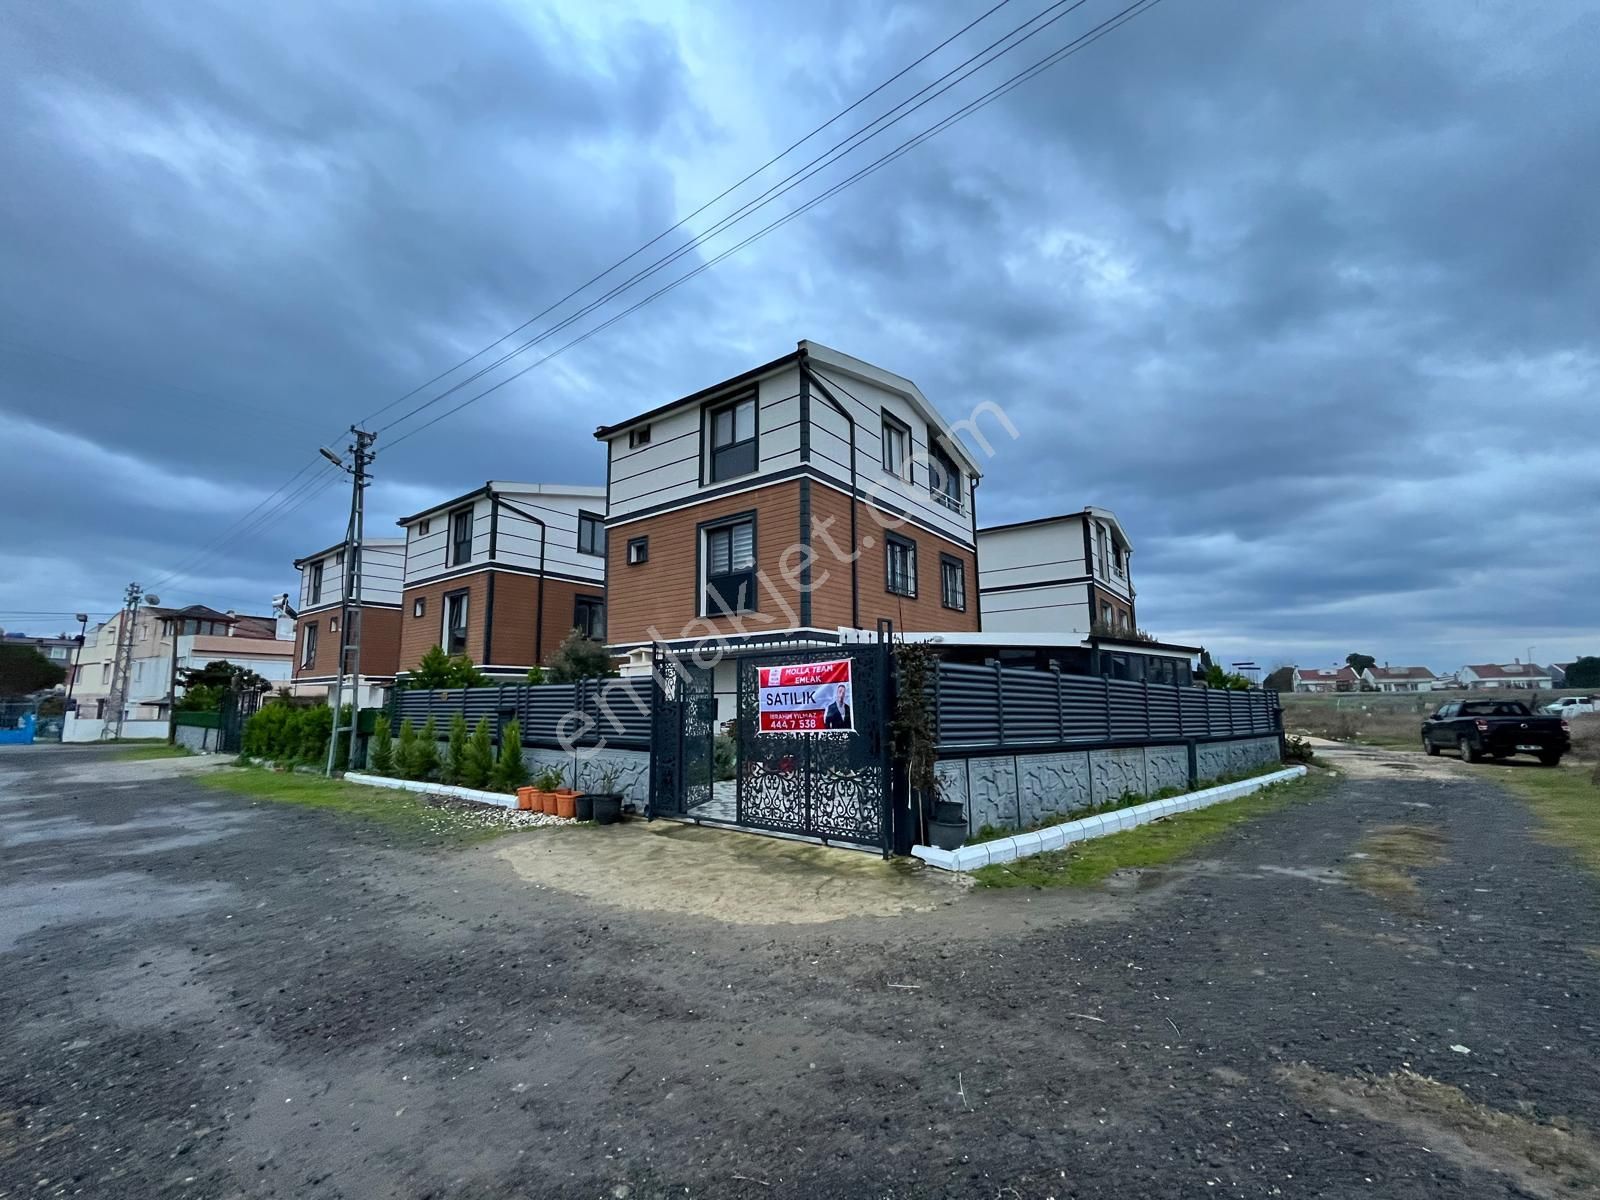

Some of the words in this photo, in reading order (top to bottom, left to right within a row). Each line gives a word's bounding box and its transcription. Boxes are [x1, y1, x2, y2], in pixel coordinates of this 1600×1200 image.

[786, 667, 810, 675] MOLLA
[812, 664, 833, 673] TEAM
[766, 691, 816, 706] SATILIK
[770, 720, 788, 728] 444
[790, 720, 796, 728] 7
[799, 720, 816, 728] 538
